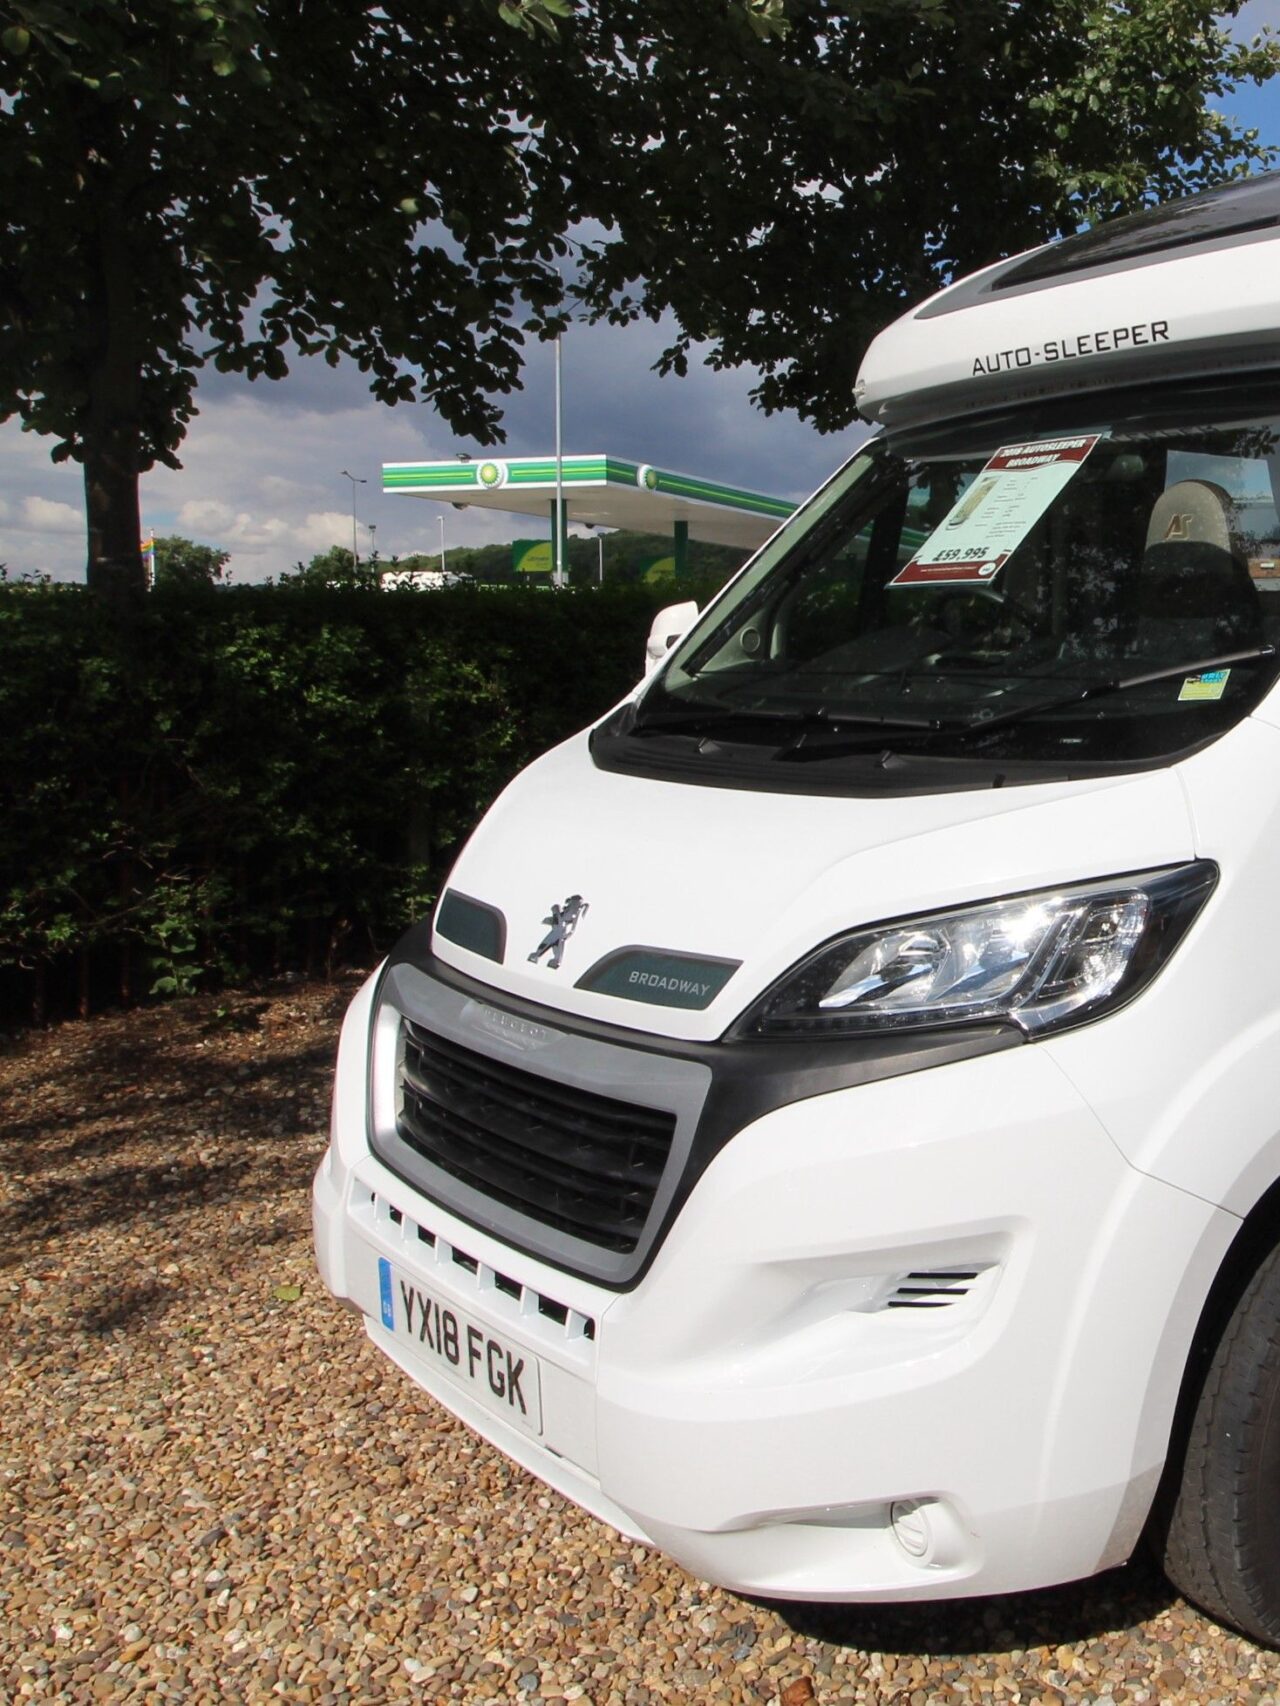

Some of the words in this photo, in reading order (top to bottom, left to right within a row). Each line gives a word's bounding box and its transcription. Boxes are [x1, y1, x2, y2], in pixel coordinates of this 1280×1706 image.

[972, 320, 1170, 376] AUTO-SLEEPER
[628, 970, 711, 997] BROADWAY
[400, 1280, 460, 1366] YX18
[467, 1324, 527, 1415] FGK
